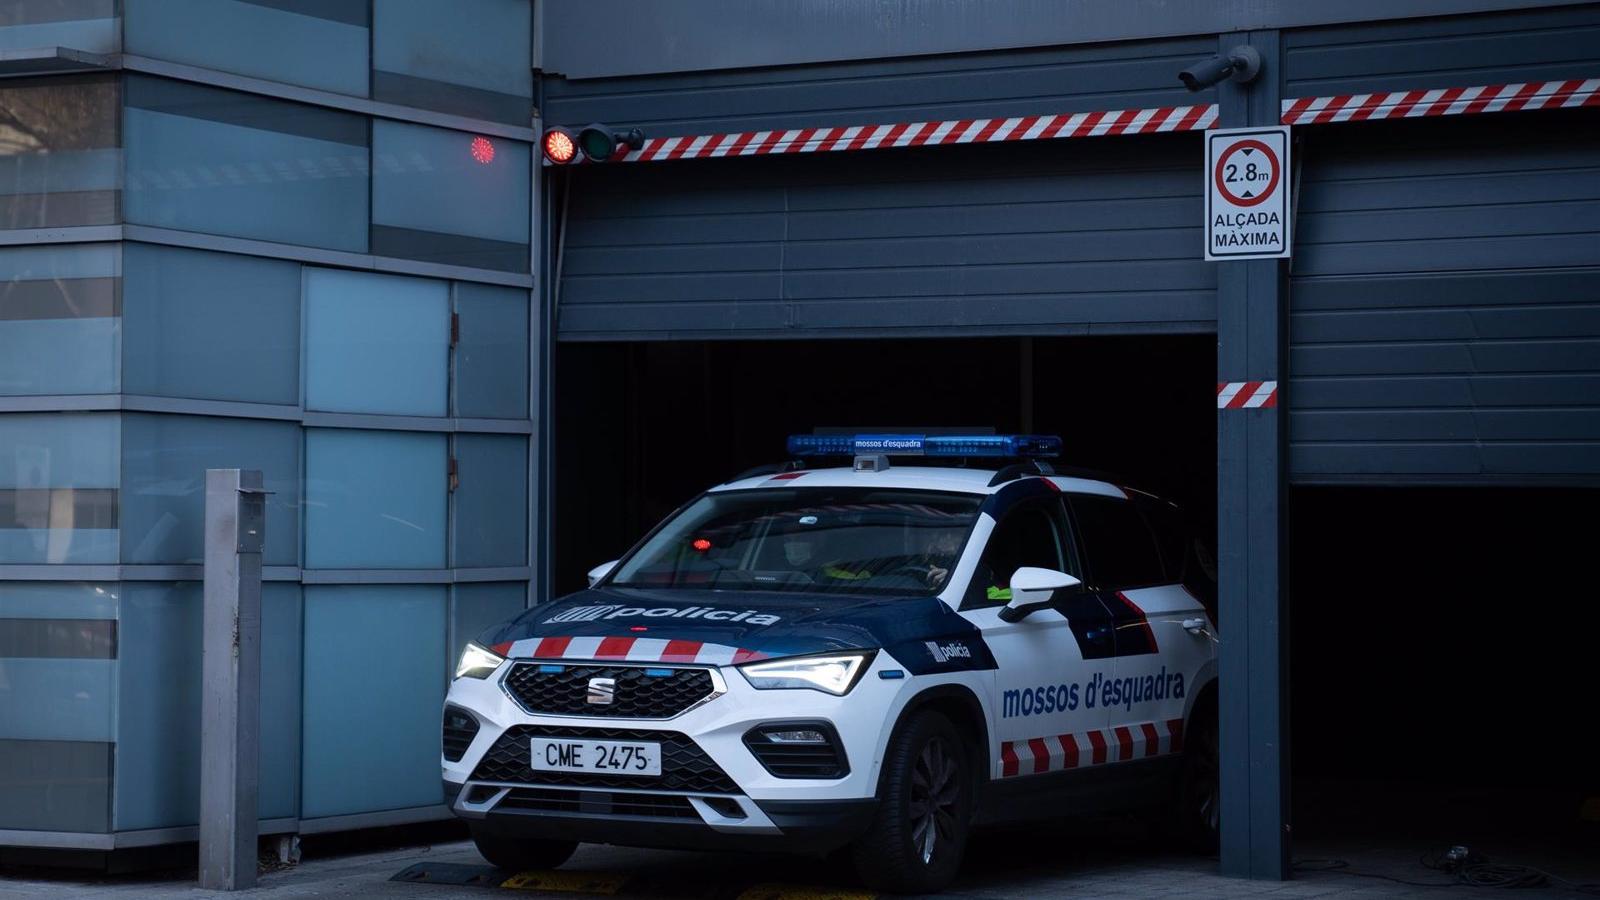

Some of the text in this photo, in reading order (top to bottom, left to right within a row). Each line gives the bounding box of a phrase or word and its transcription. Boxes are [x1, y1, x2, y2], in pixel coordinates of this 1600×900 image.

[1214, 212, 1280, 229] ALÇADA
[1215, 230, 1280, 247] MÀXIMA
[855, 440, 882, 448] mossos
[603, 606, 782, 626] policia
[1003, 684, 1079, 718] mossos
[545, 743, 648, 770] CME 2475
